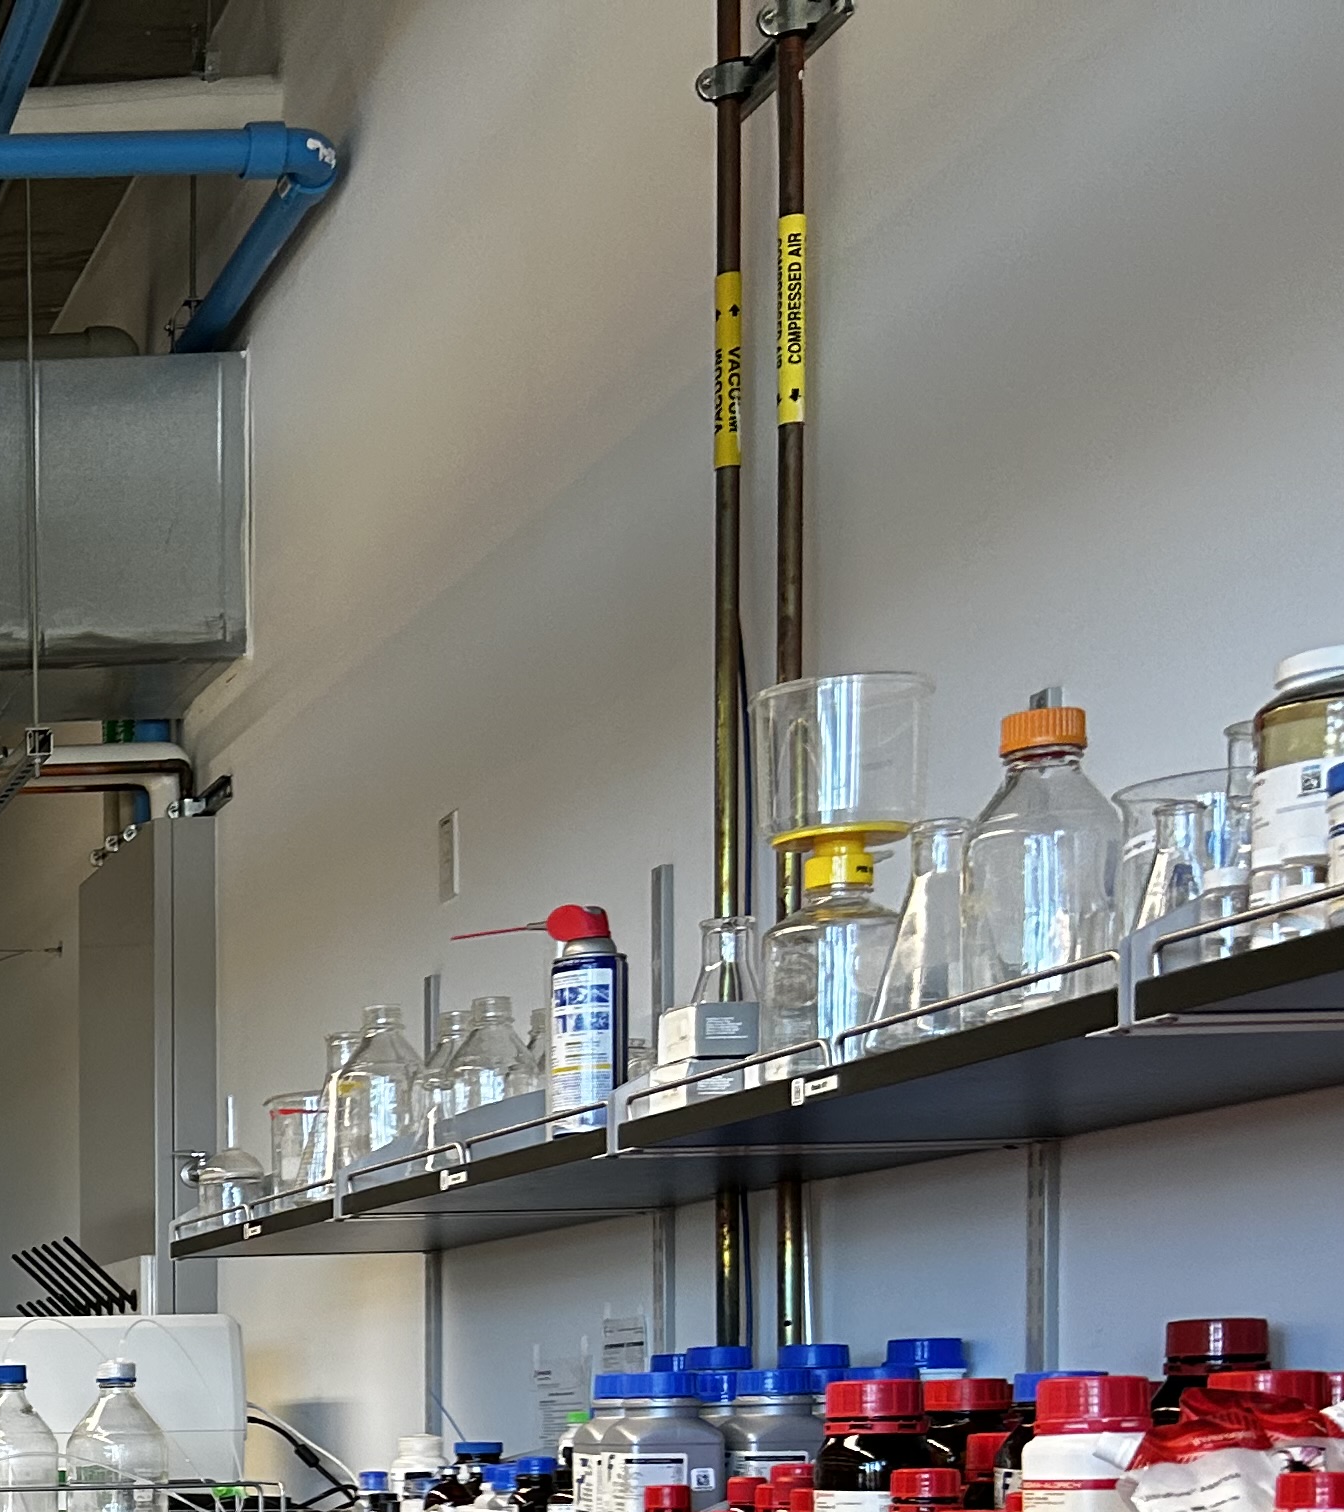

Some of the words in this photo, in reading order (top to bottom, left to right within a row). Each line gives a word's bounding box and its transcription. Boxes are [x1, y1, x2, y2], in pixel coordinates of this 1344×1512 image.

[787, 232, 802, 258] AIR
[787, 262, 802, 364] COMPRESSED
[728, 347, 740, 433] VACUUM
